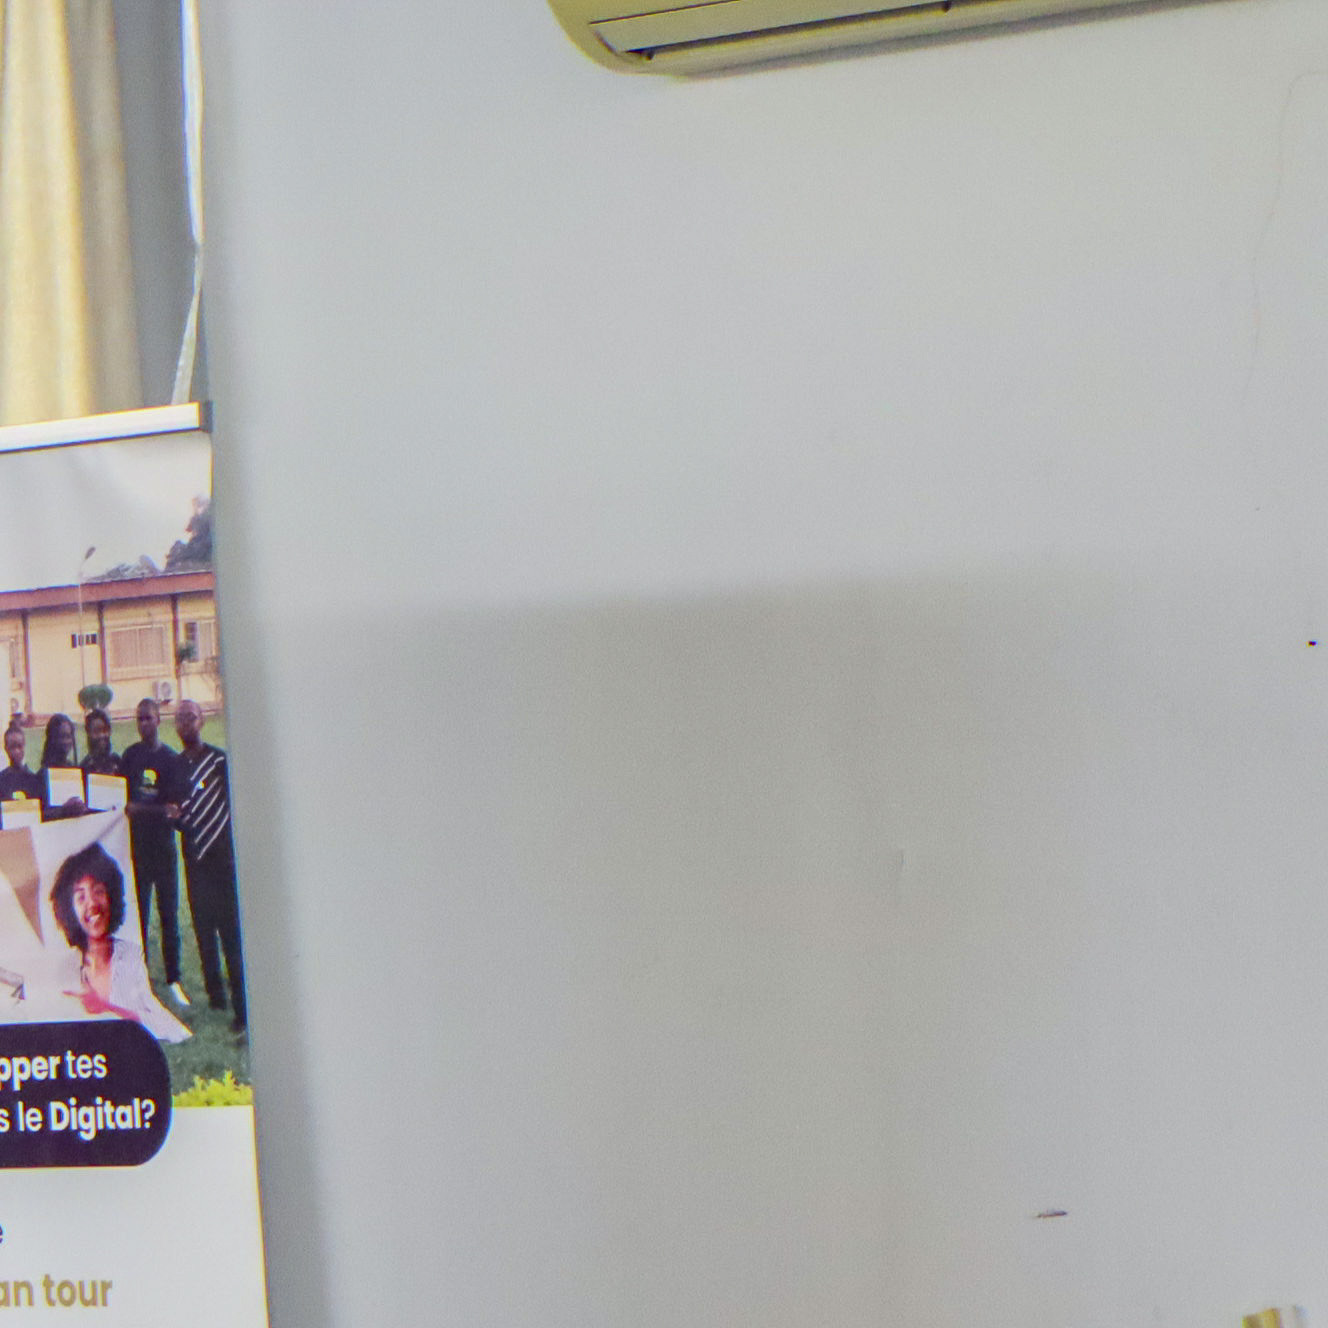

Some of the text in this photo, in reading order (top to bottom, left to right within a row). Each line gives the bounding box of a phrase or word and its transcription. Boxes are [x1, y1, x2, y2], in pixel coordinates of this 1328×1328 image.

[65, 1050, 108, 1080] tes
[18, 1101, 42, 1132] le
[50, 1097, 155, 1141] Digital?
[43, 1275, 113, 1308] tour
